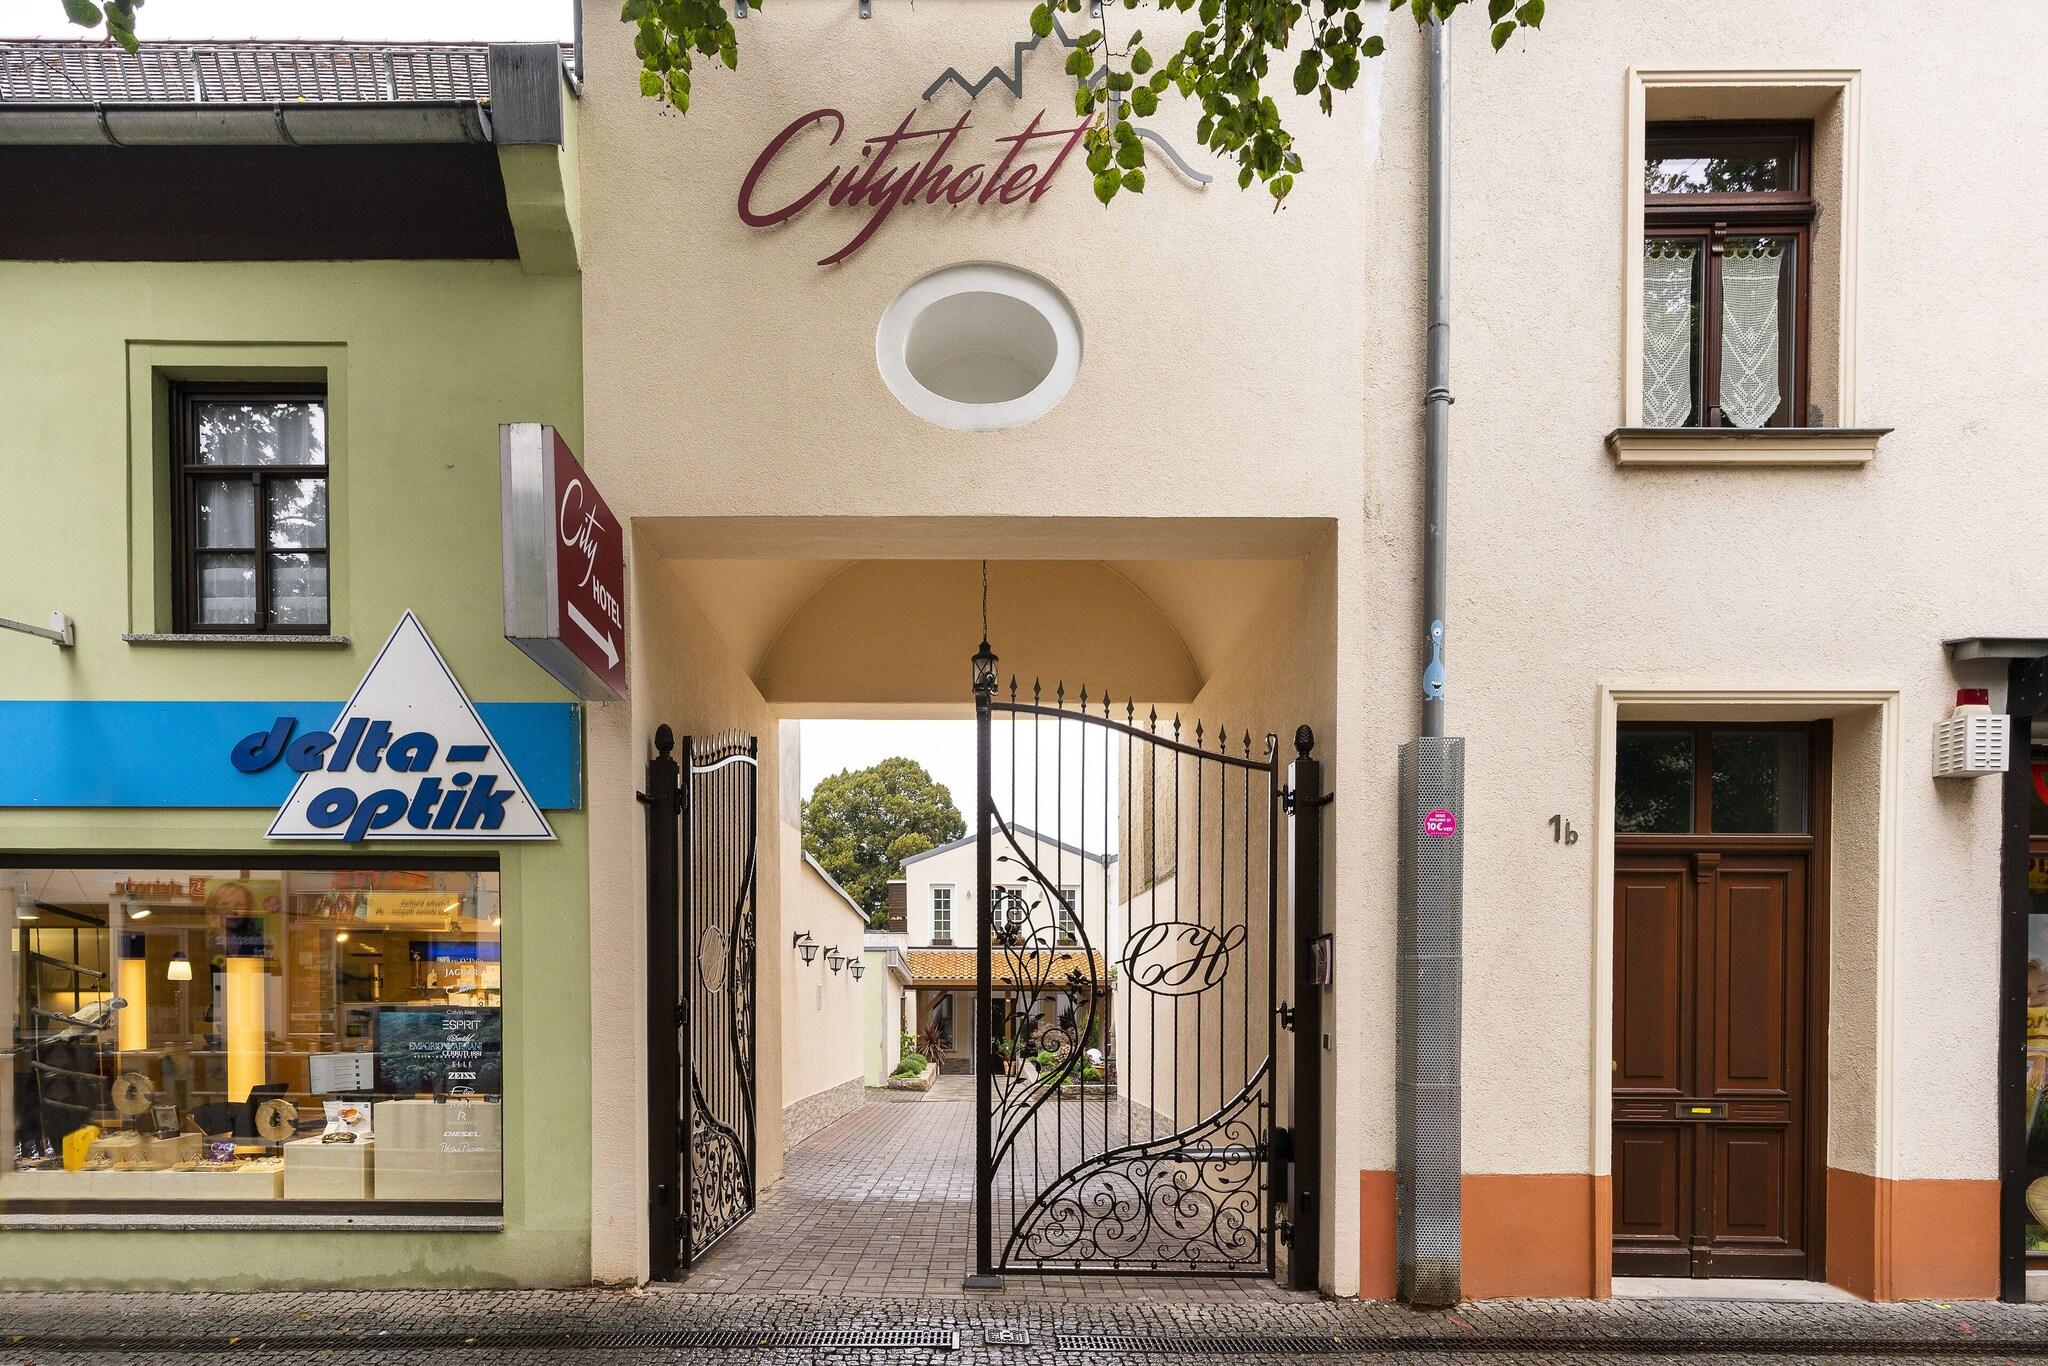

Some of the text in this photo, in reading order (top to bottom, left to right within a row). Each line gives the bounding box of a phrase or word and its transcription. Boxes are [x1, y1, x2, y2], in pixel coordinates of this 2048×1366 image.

[738, 108, 1096, 266] Cityhotel
[560, 478, 606, 588] City
[592, 575, 623, 630] HOTEL
[306, 771, 515, 844] optik
[1548, 814, 1579, 845] 1b
[445, 968, 479, 977] JAGR
[442, 1020, 481, 1030] ESPRIT
[409, 1041, 443, 1051] EMPORIO
[448, 1072, 477, 1080] ZEISS
